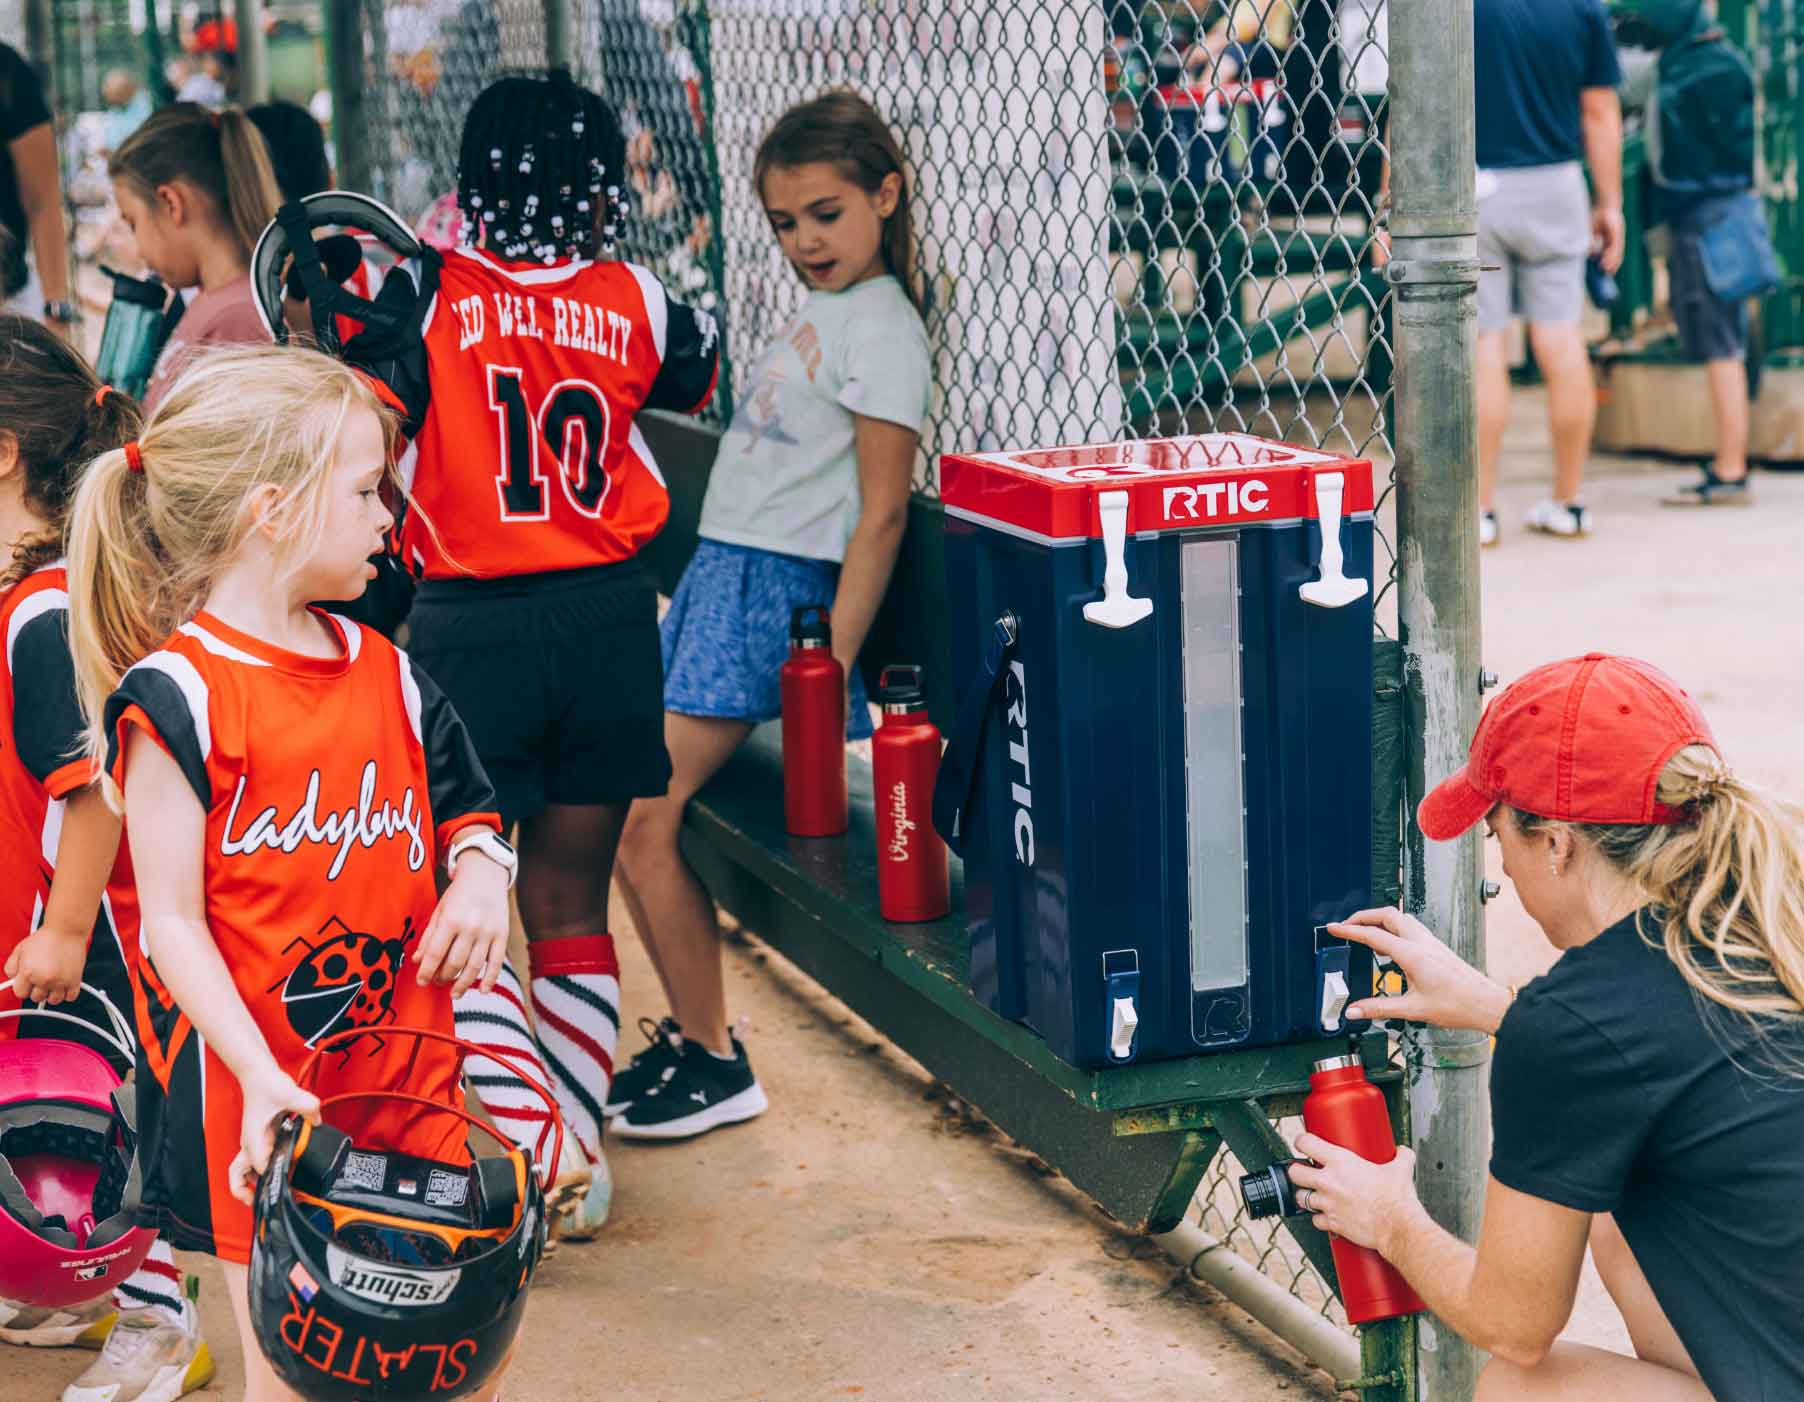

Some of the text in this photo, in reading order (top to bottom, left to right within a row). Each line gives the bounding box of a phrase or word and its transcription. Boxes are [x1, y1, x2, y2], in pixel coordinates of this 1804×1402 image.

[552, 296, 632, 367] REALTY
[486, 363, 612, 523] 10
[1162, 479, 1270, 521] RTIC
[1006, 659, 1035, 868] RTIC
[220, 759, 426, 881] Ladybug
[888, 781, 917, 862] Virginia
[279, 1291, 478, 1393] SLATER
